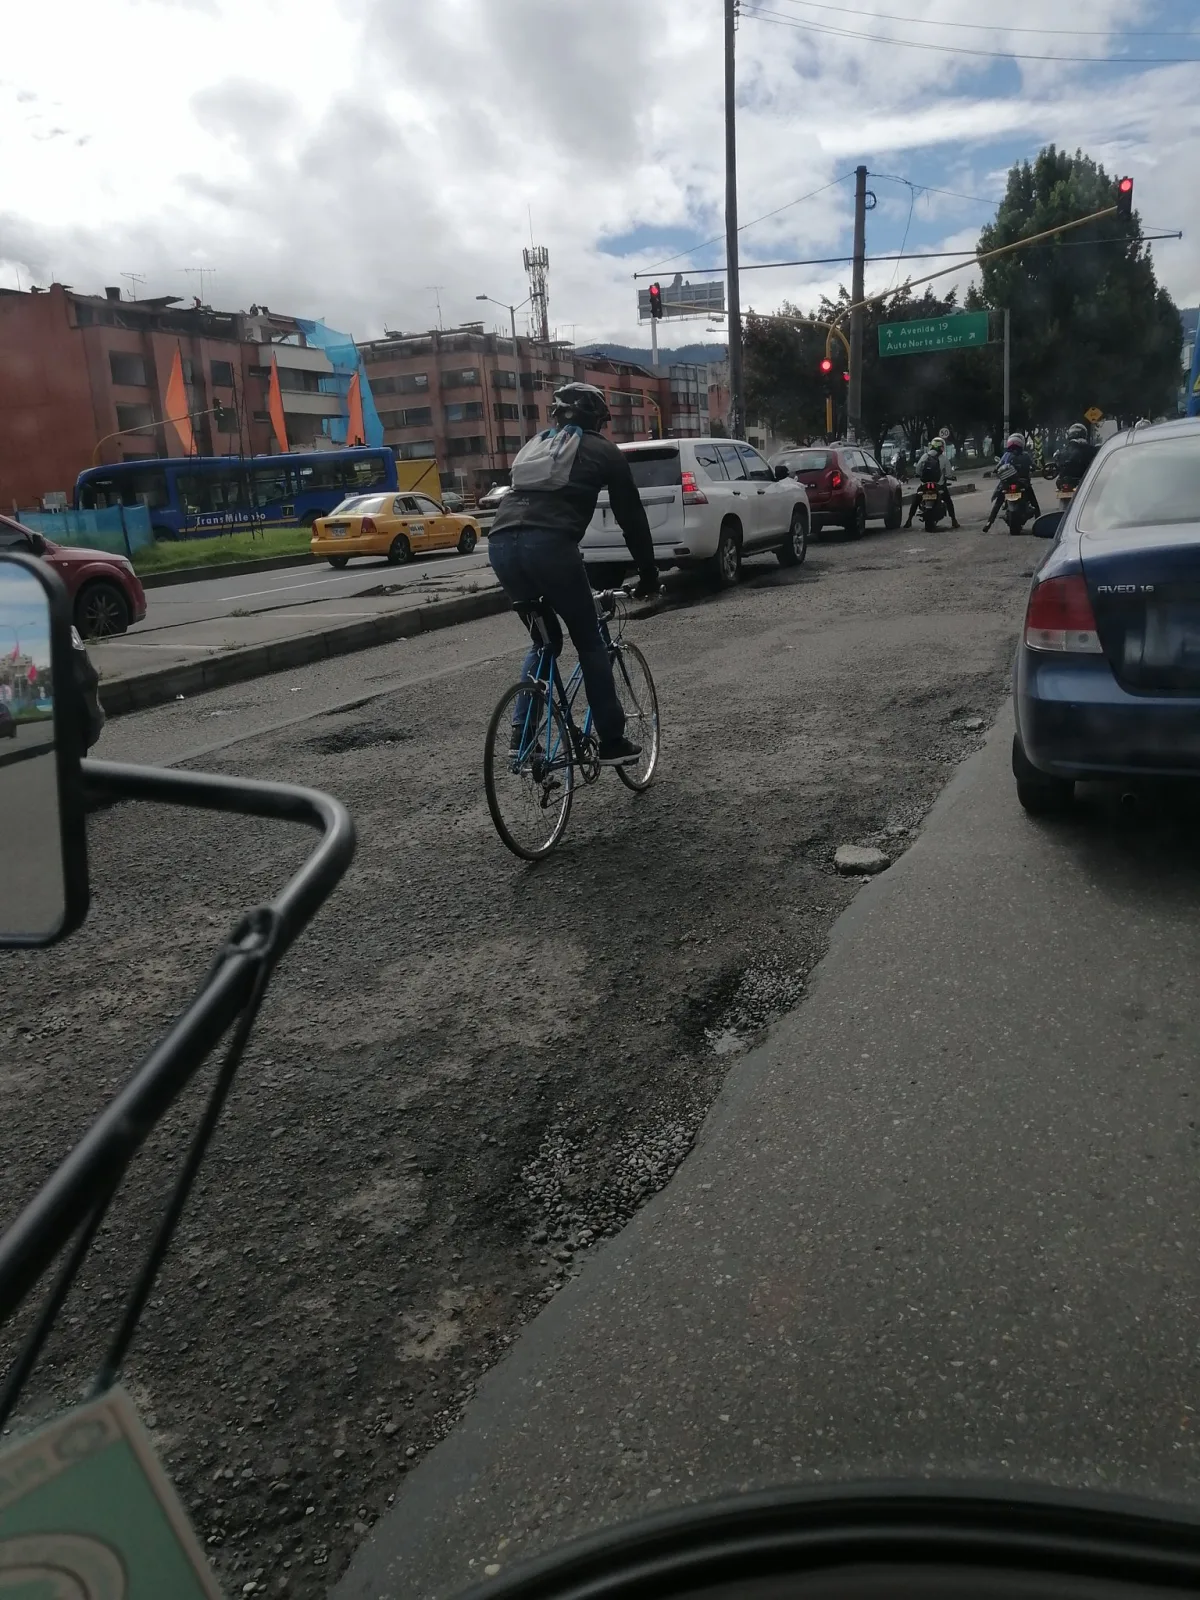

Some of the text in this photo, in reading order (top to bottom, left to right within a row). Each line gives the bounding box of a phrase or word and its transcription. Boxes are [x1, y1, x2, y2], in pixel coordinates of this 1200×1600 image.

[900, 322, 949, 336] Avenida 19
[886, 335, 963, 350] Auto Norte al Sur
[940, 429, 949, 437] 50
[1097, 584, 1136, 594] AVEO
